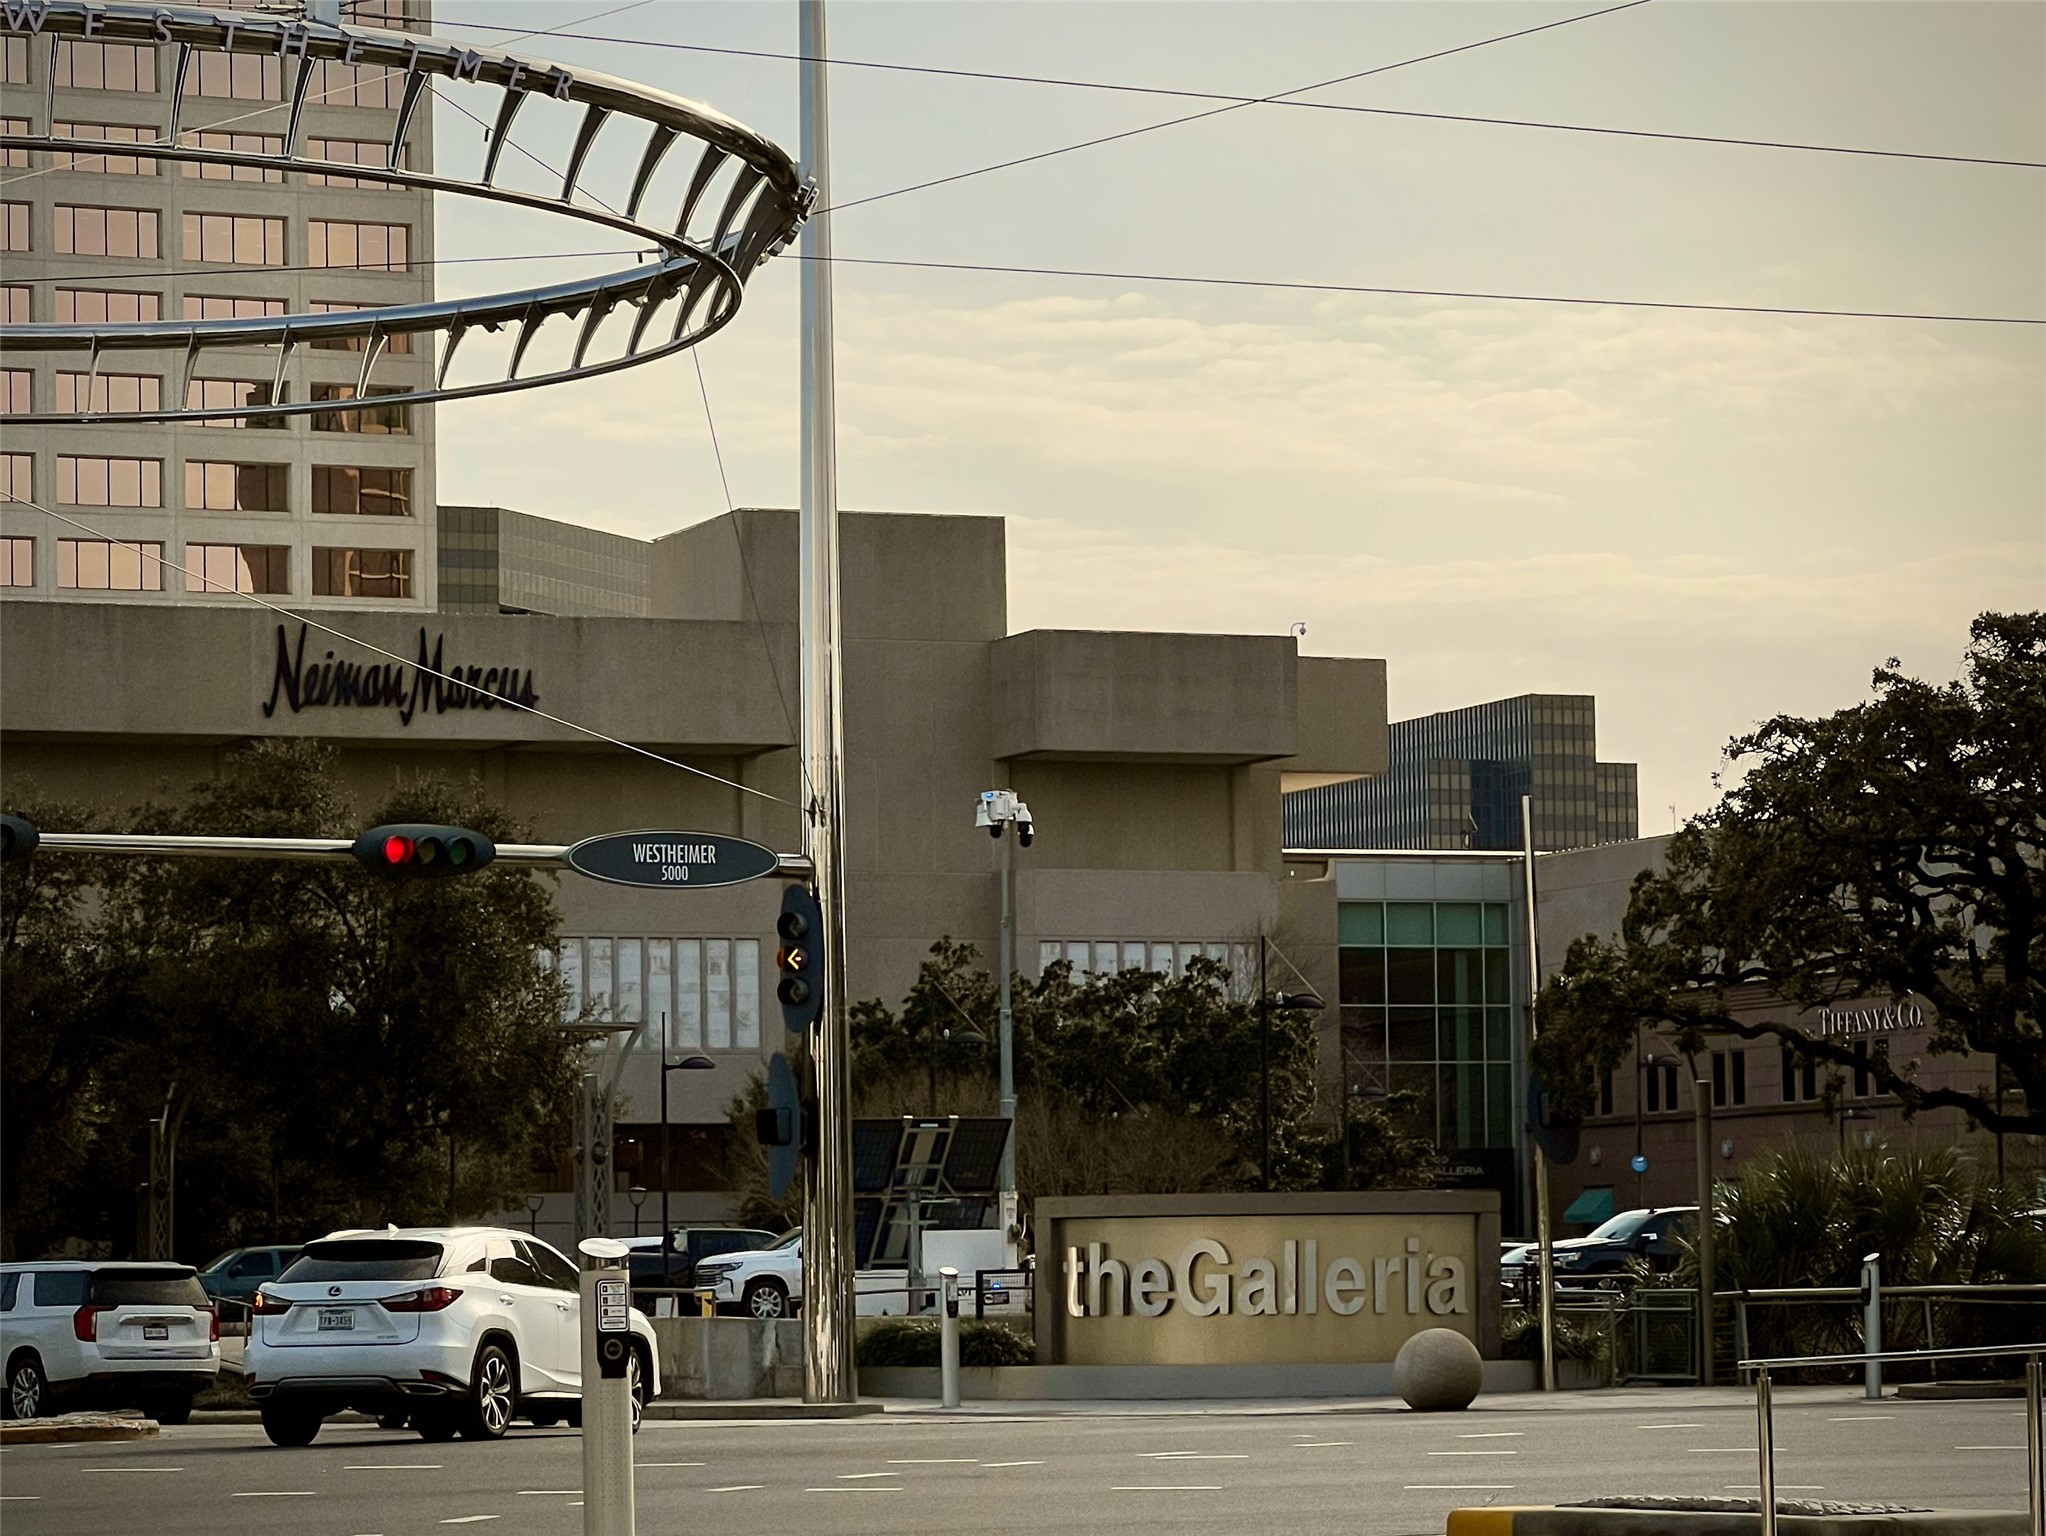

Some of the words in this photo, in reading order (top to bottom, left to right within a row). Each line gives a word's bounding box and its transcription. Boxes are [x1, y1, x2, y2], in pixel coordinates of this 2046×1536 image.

[2, 1, 573, 102] WESTHEIMER
[263, 622, 407, 718] Neiman
[400, 626, 540, 726] Marcus
[632, 843, 716, 864] WESTHEIMER
[661, 865, 689, 881] 5000
